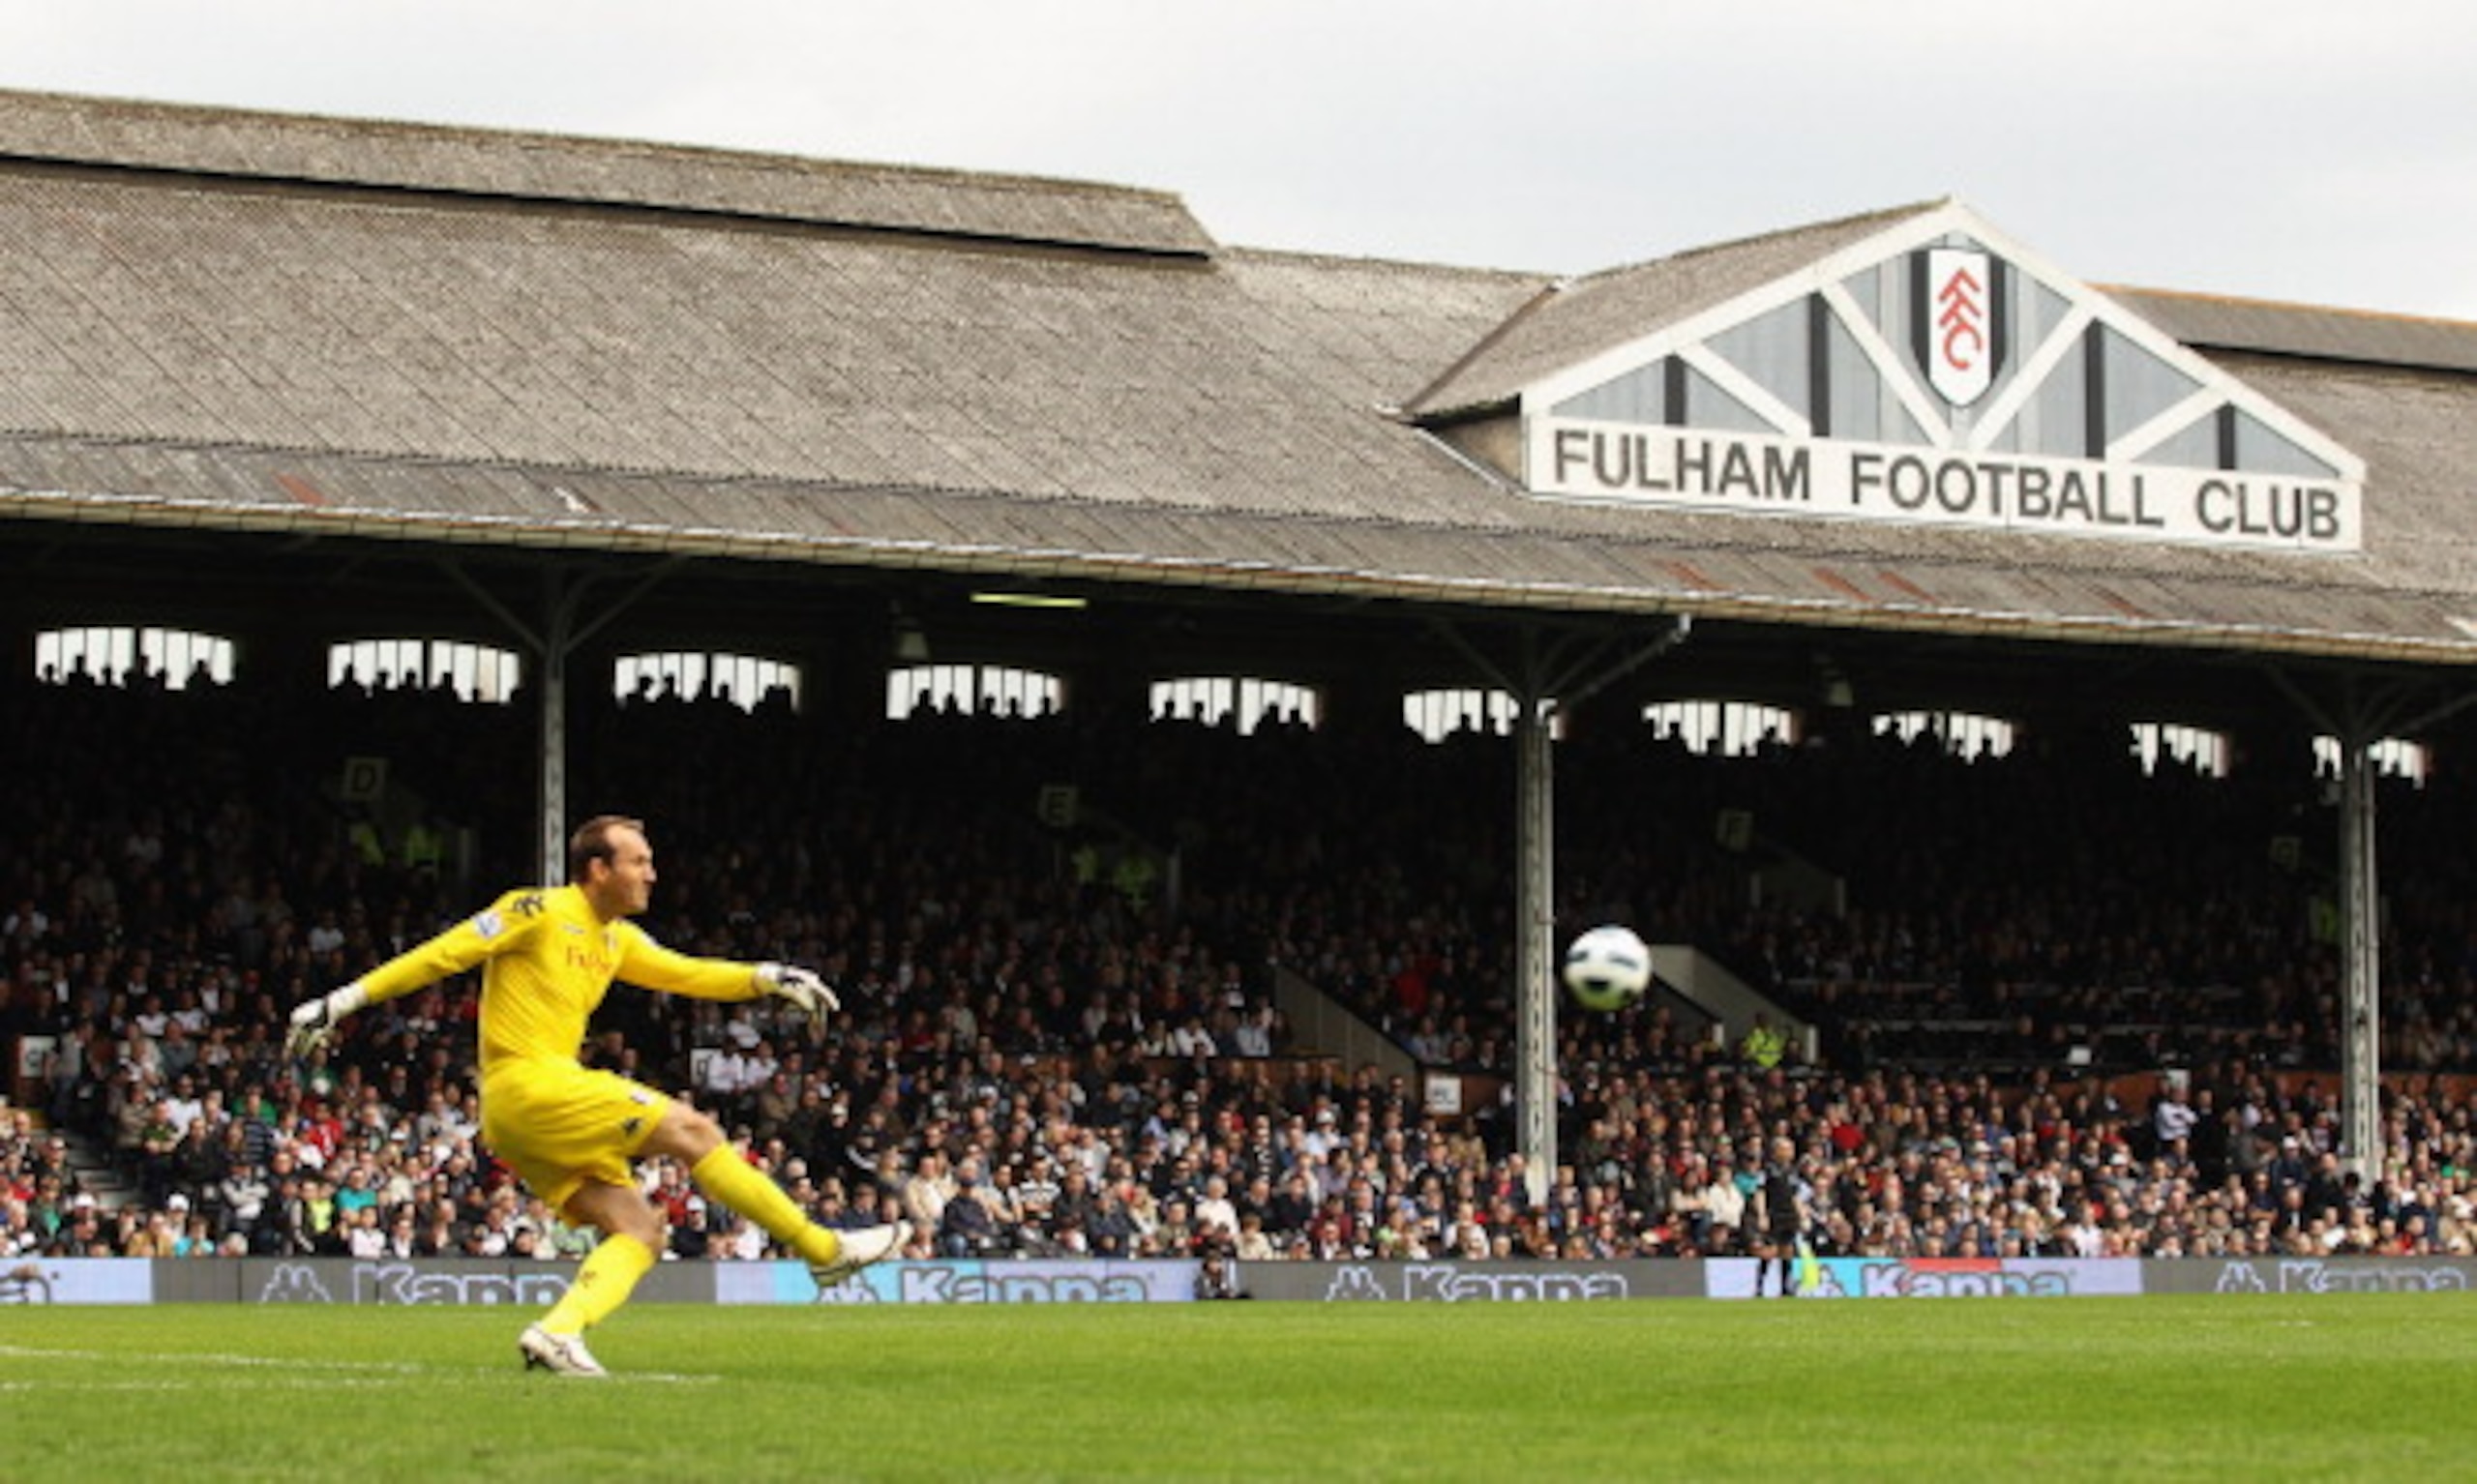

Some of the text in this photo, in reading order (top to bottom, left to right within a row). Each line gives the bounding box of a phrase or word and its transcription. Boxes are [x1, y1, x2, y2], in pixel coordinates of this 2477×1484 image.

[1554, 429, 2342, 538] FULHAM FOOTBALL CLUB
[352, 762, 376, 792] D
[352, 1262, 582, 1305] Kapp
